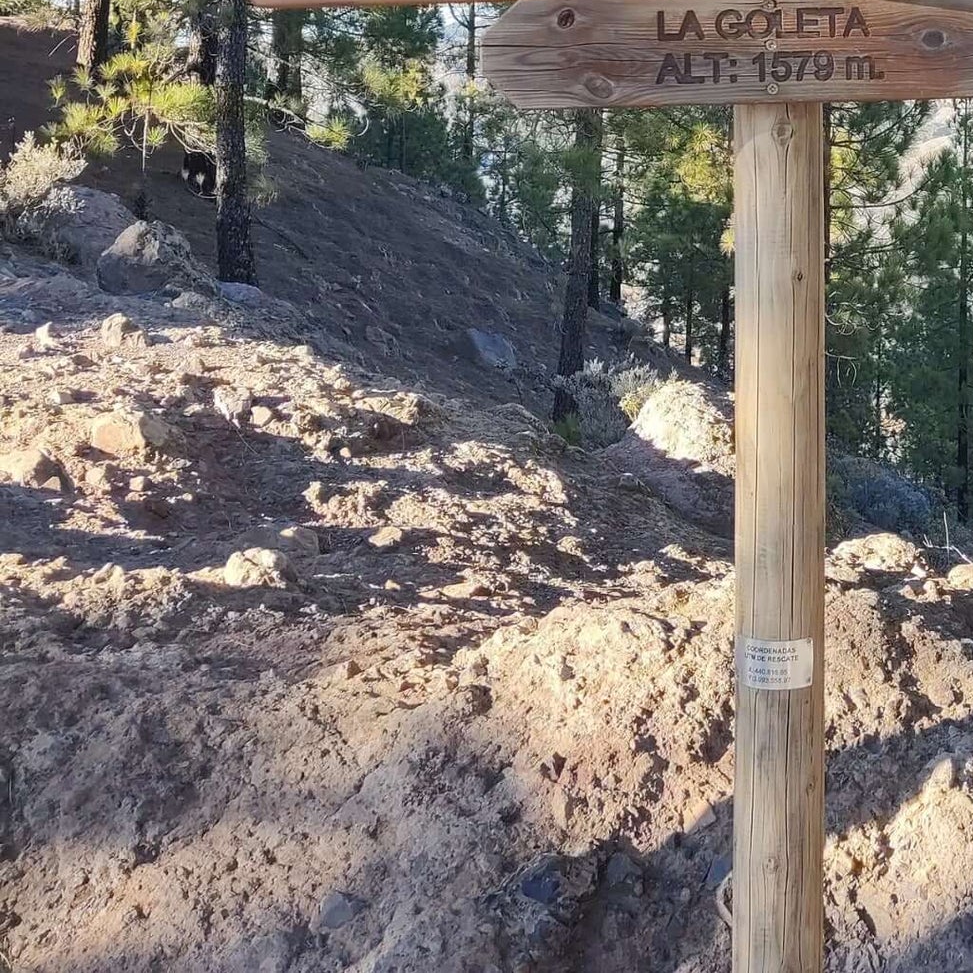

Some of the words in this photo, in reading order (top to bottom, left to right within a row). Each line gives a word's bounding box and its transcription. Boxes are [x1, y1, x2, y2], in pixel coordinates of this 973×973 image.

[656, 9, 701, 42] LA
[715, 5, 872, 40] GOLETA
[655, 51, 738, 86] ALT:
[750, 48, 834, 83] 1579
